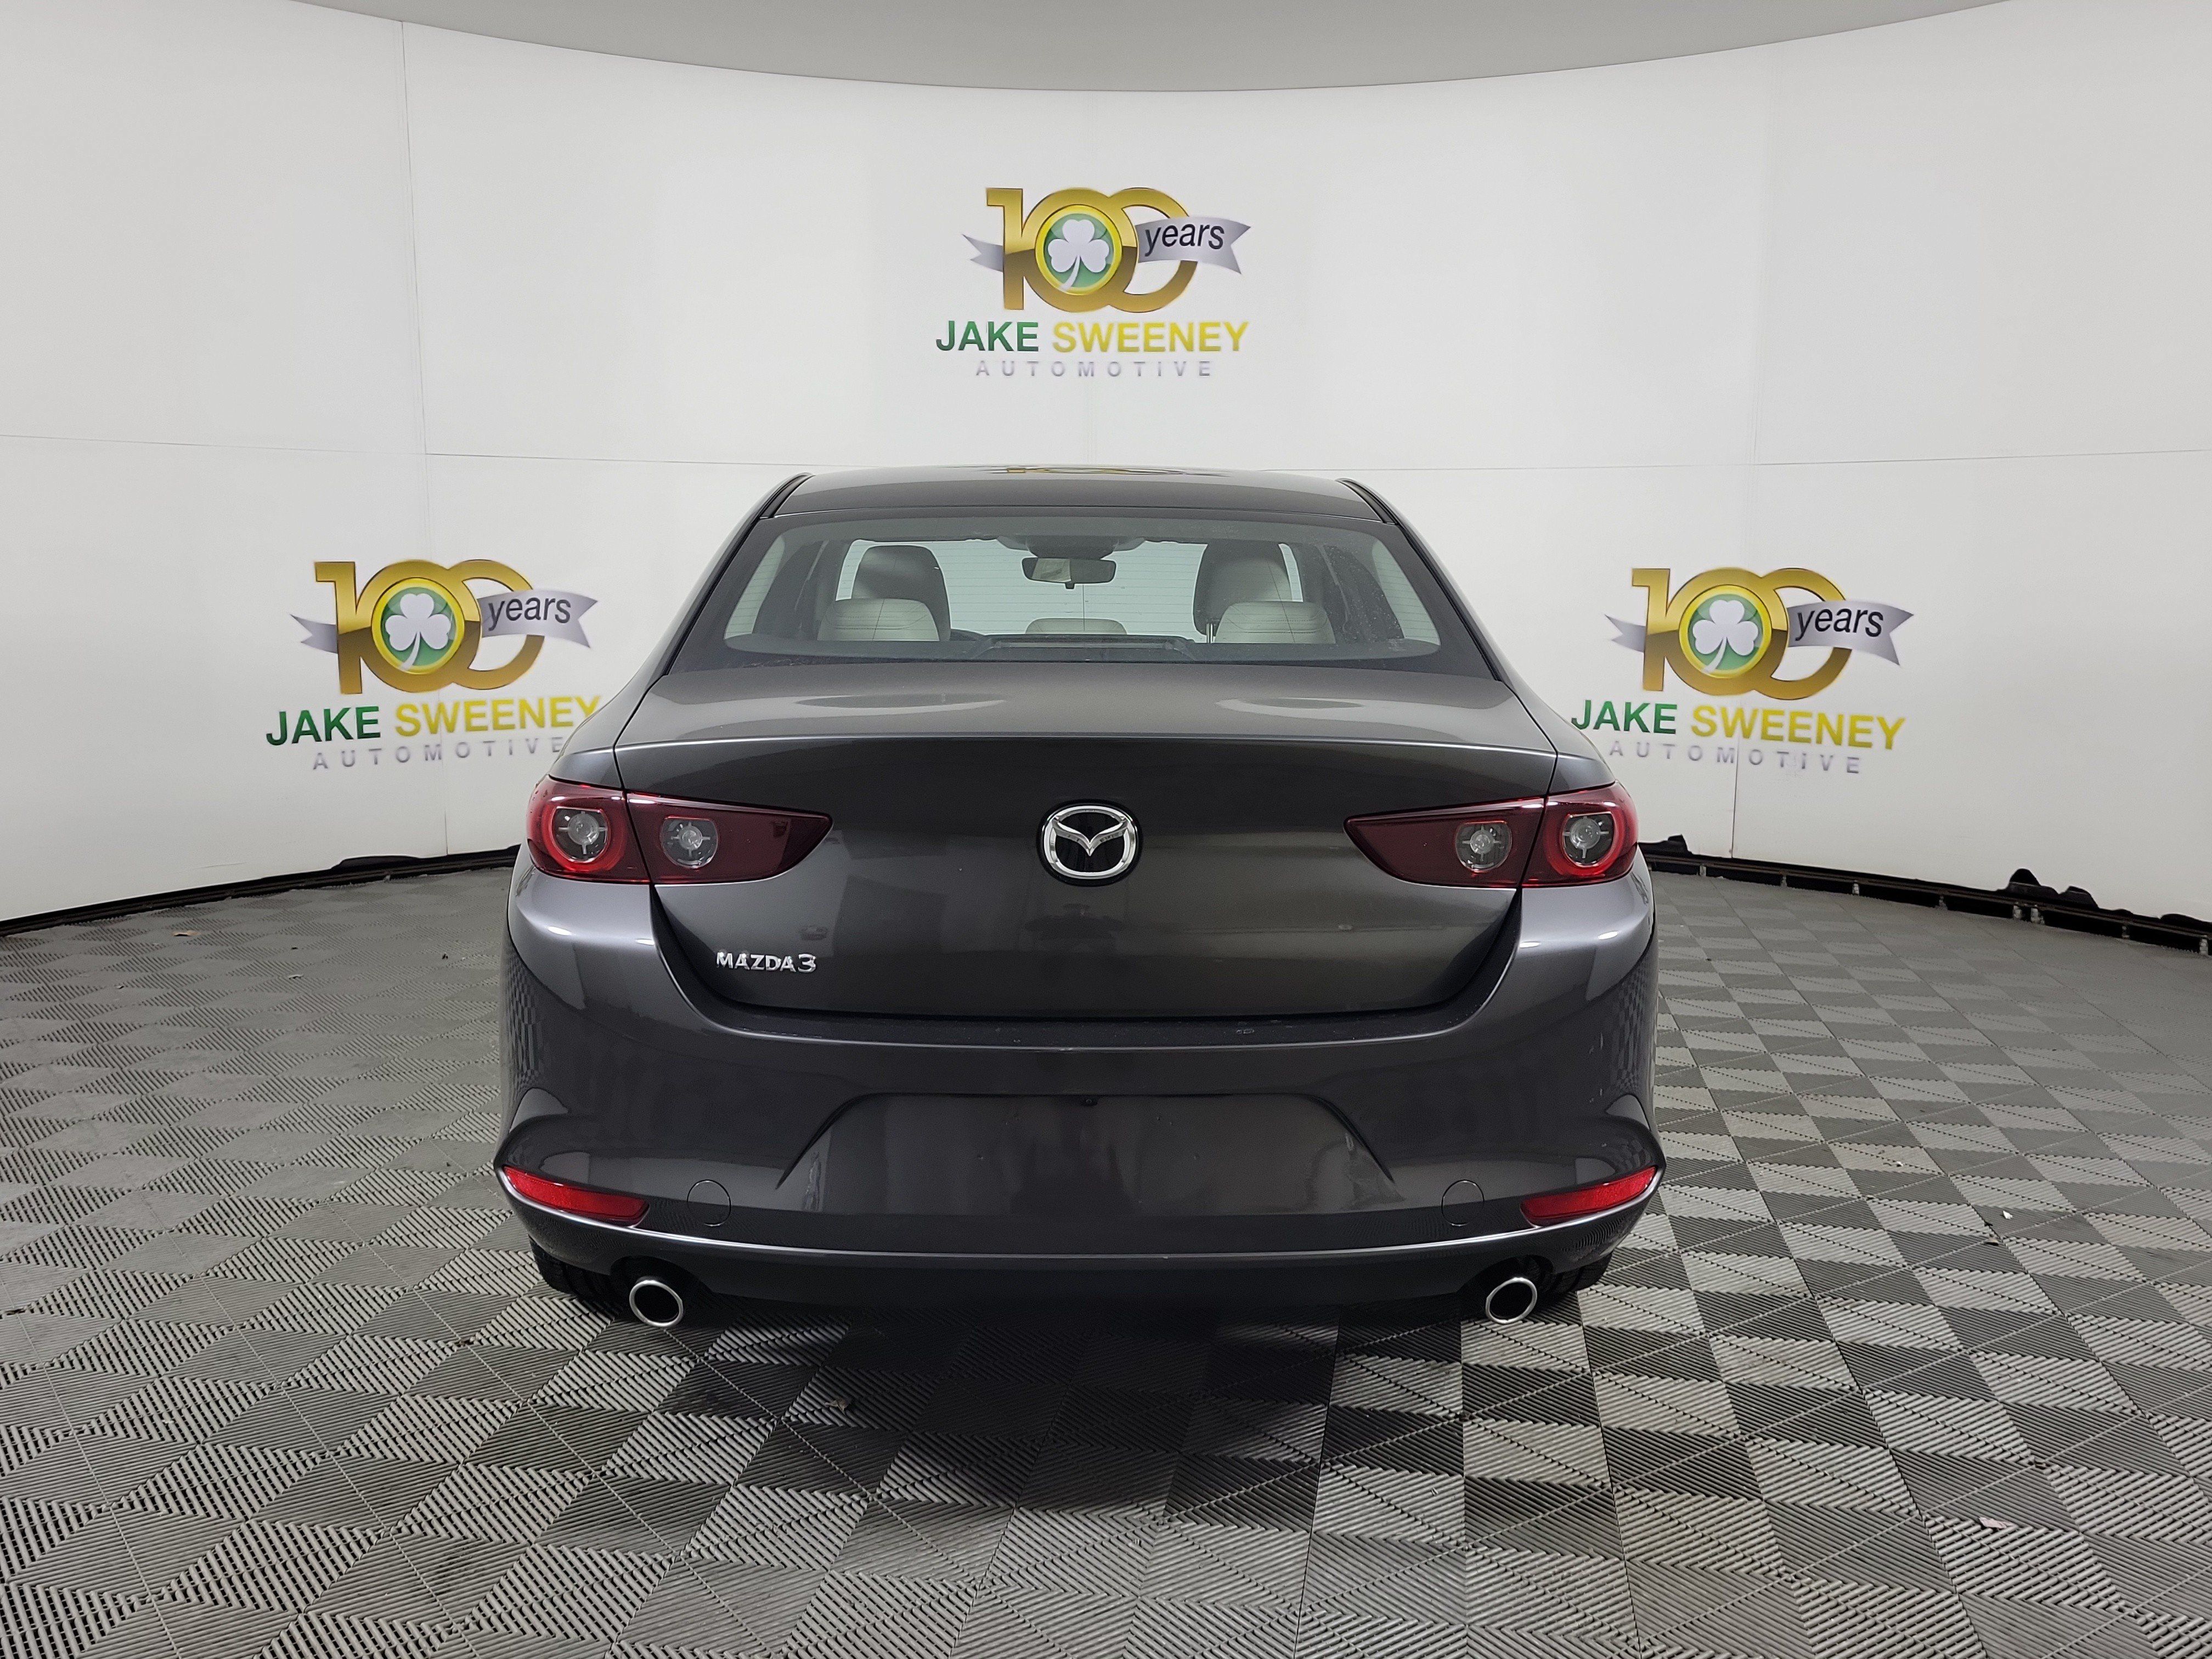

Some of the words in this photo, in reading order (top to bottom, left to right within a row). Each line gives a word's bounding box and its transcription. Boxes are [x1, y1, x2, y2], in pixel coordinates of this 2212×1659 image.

[985, 187, 1198, 313] 100
[1144, 223, 1225, 257] years
[935, 320, 1040, 352] JAKE
[1052, 321, 1249, 353] SWEENEY
[975, 360, 1211, 377] AUTOMOTIVE
[314, 558, 545, 695] 100
[488, 596, 572, 632] years
[1632, 567, 1852, 701] 100
[1795, 607, 1884, 641] years
[266, 706, 381, 746] JAKE
[395, 696, 601, 737] SWEENEY
[1571, 699, 1677, 735] JAKE
[1690, 705, 1906, 750] SWEENEY
[312, 736, 563, 770] AUTOMOTIVE
[1609, 741, 1860, 774] AUTOMOTIVE
